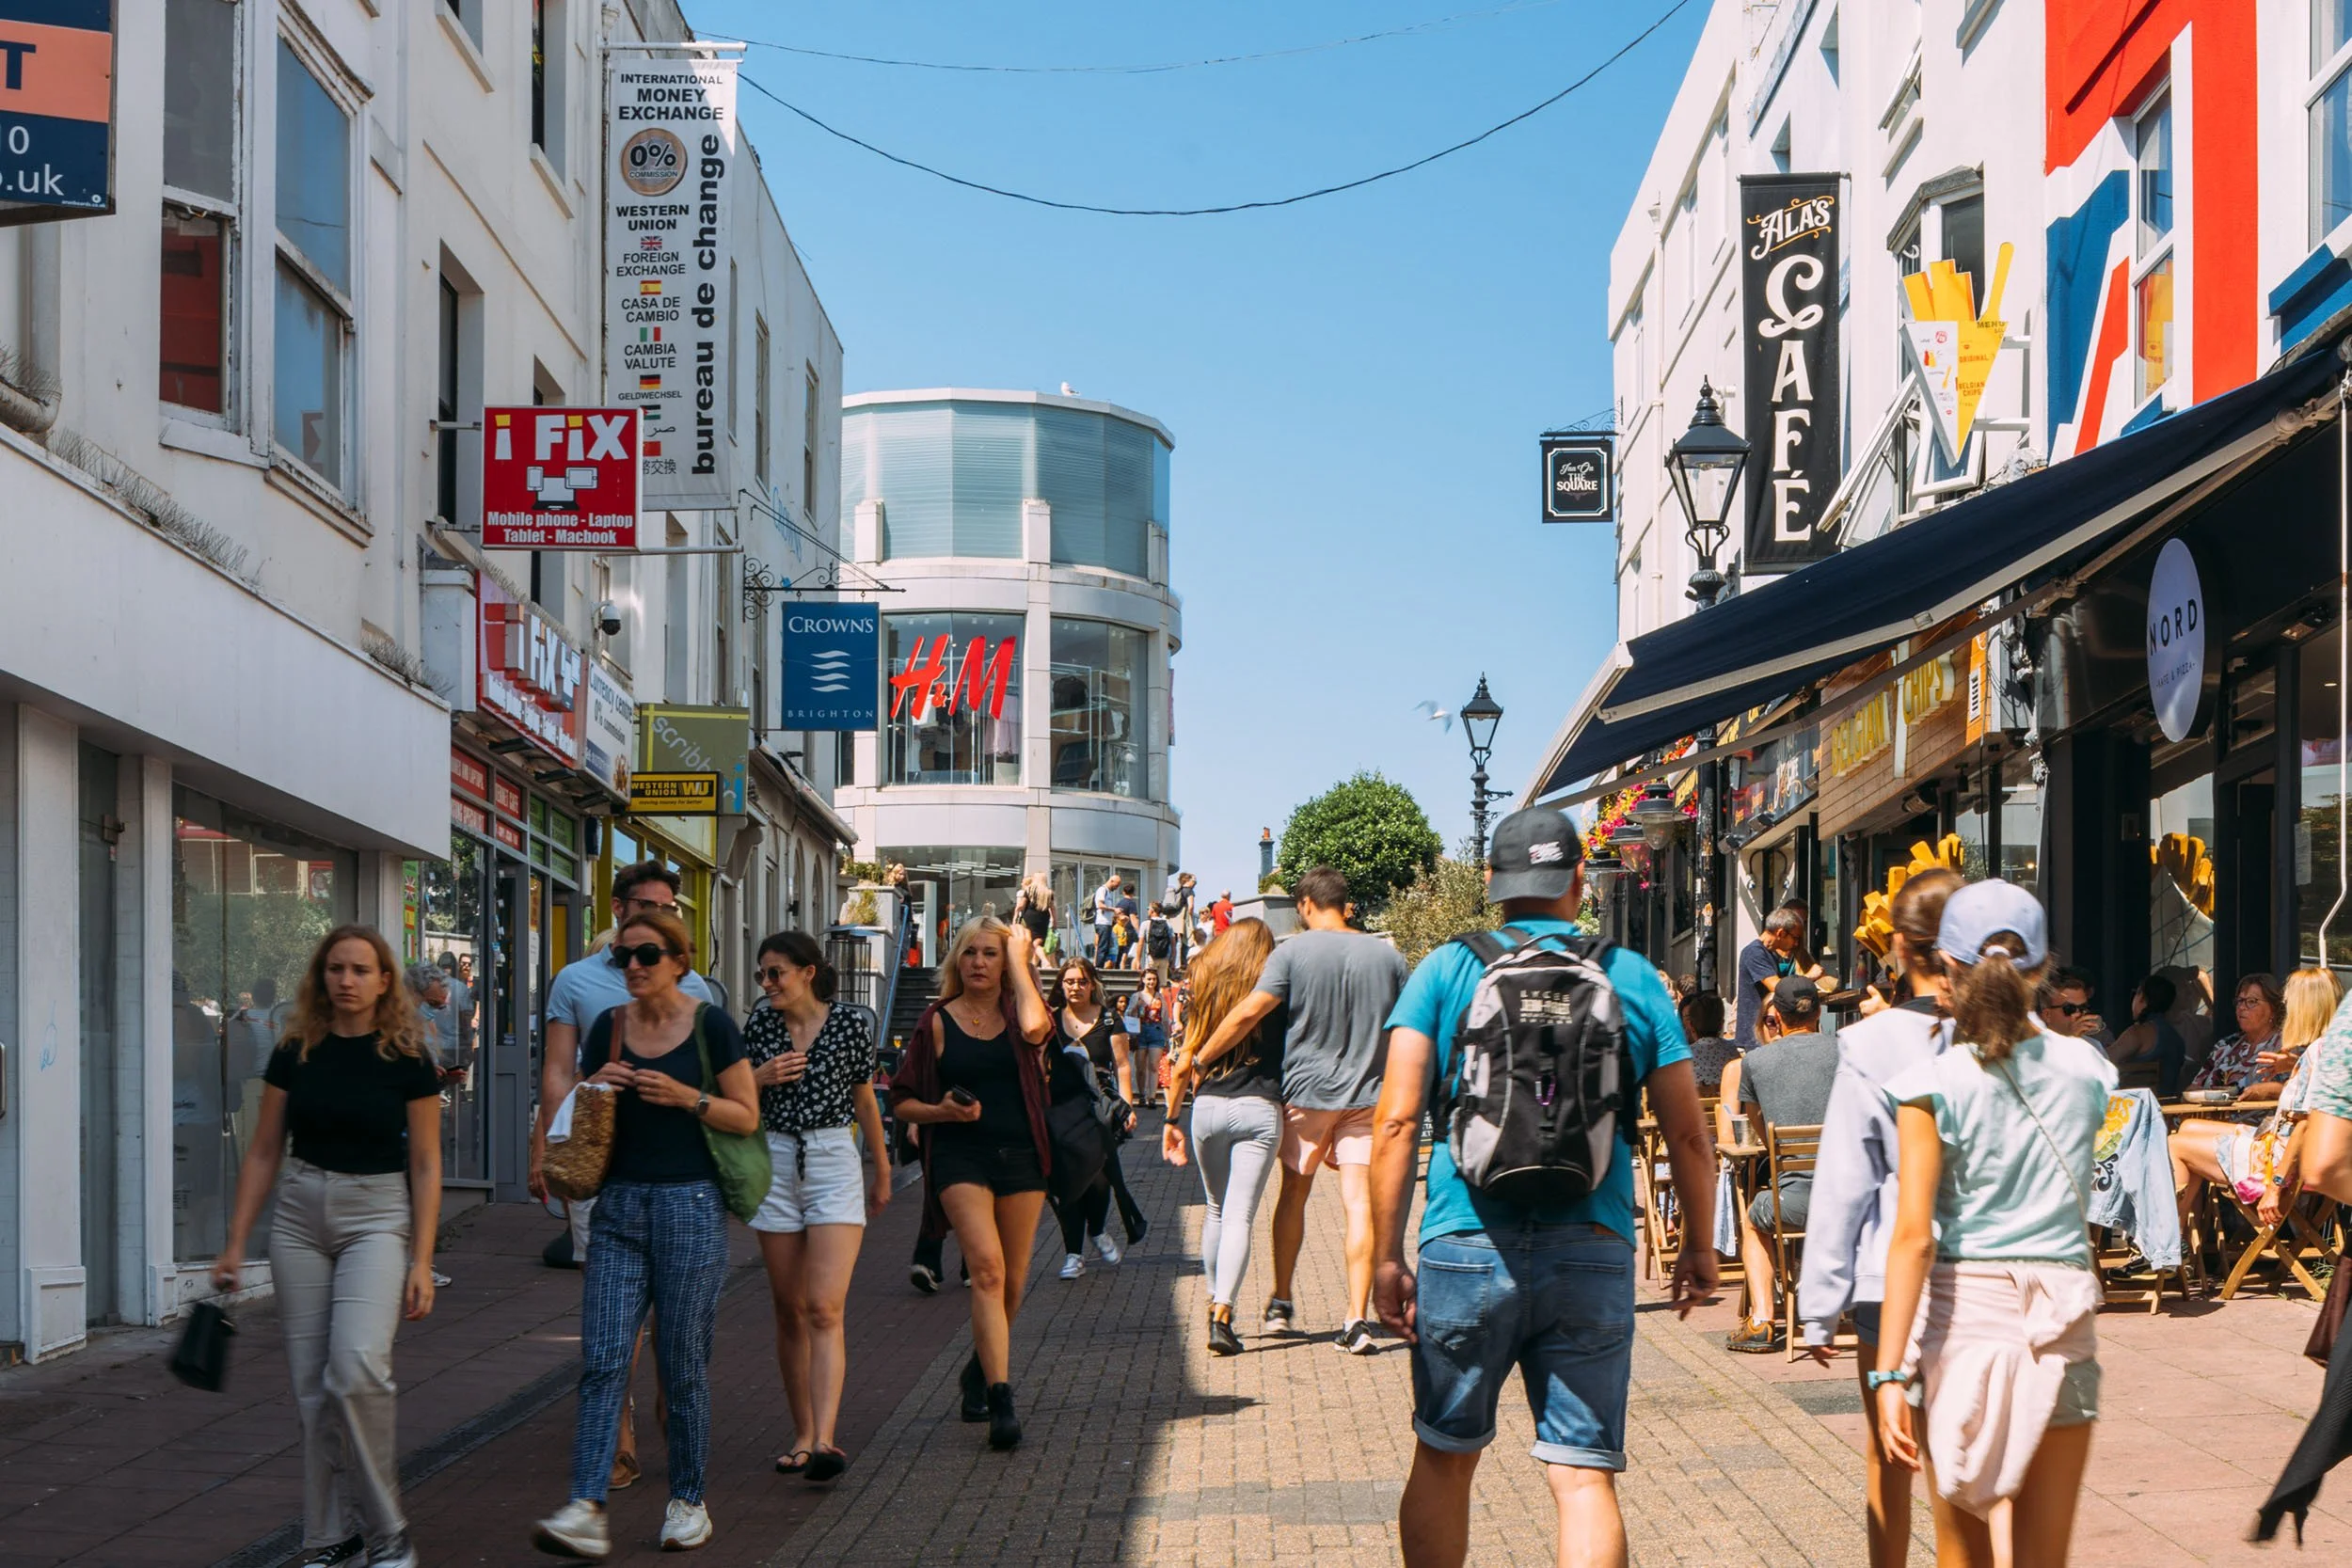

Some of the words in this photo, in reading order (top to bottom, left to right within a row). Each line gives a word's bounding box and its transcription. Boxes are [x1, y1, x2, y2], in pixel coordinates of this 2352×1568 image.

[620, 73, 723, 85] INTERNATIONAL
[637, 88, 707, 103] MONEY
[618, 106, 723, 120] EXCHANGE
[629, 143, 677, 167] 0%
[628, 170, 678, 179] COMMISSION
[692, 134, 725, 271] change
[616, 204, 690, 217] WESTERN
[628, 219, 677, 231] UNION
[623, 251, 680, 264] FOREIGN
[616, 263, 687, 277] EXCHANGE
[621, 297, 659, 310] CASA
[662, 296, 681, 309] DE
[691, 282, 716, 329] de
[626, 309, 680, 324] CAMBIO
[624, 343, 677, 356] CAMBIA
[624, 356, 676, 370] VALUTE
[618, 390, 682, 401] GELDWECHSEL
[691, 341, 716, 475] bureau
[1560, 462, 1577, 475] Inn
[1577, 462, 1594, 473] On
[1567, 472, 1586, 482] THE
[1556, 481, 1598, 491] SQUARE
[487, 512, 532, 526] Mobile
[535, 513, 578, 528] phone
[588, 513, 633, 528] Laptop
[503, 529, 546, 543] Tablet
[555, 530, 617, 544] Macbook
[2150, 598, 2198, 657] NORD
[889, 633, 1017, 721] H&M
[590, 663, 615, 713] Currency
[615, 694, 633, 724] centre
[1903, 657, 1945, 725] CHIPS
[787, 709, 874, 719] BRIGHTON
[1832, 691, 1885, 777] BELGIAN
